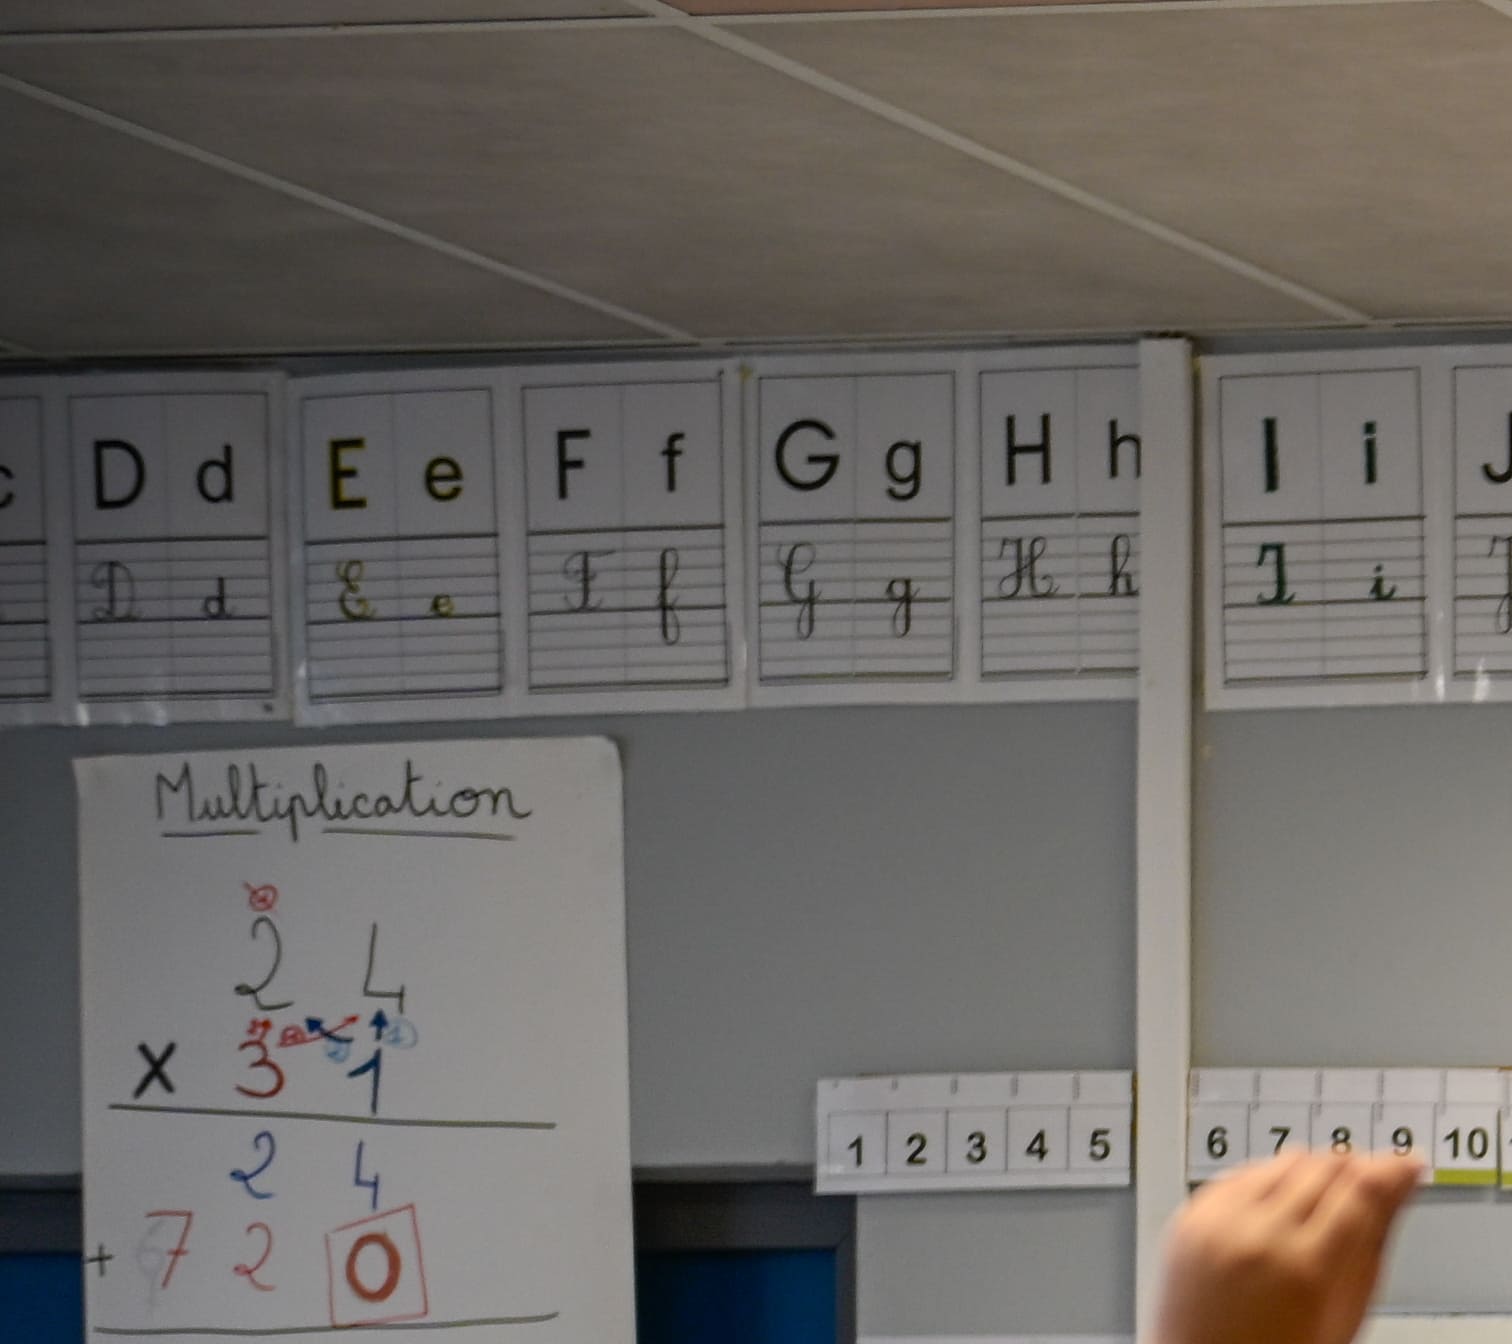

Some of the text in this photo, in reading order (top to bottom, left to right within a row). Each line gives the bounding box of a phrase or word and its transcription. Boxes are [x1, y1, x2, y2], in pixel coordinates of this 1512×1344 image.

[92, 438, 234, 511] D d
[328, 437, 464, 511] E e
[556, 428, 686, 500] F f
[774, 418, 922, 502] G g
[1005, 413, 1141, 486] H h
[1263, 417, 1377, 493] I i
[152, 759, 535, 842] Multiplication
[233, 915, 410, 1014] 2 4
[235, 1040, 382, 1113] 3 1
[228, 1130, 380, 1211] 2 4
[848, 1135, 863, 1167] 1
[906, 1132, 928, 1166] 2
[966, 1131, 988, 1164] 3
[1025, 1129, 1048, 1161] 4
[1089, 1128, 1111, 1161] 5
[1206, 1126, 1228, 1159] 6
[1389, 1122, 1415, 1159] 9
[1444, 1127, 1489, 1160] 10
[145, 1210, 402, 1303] 7 2 0
